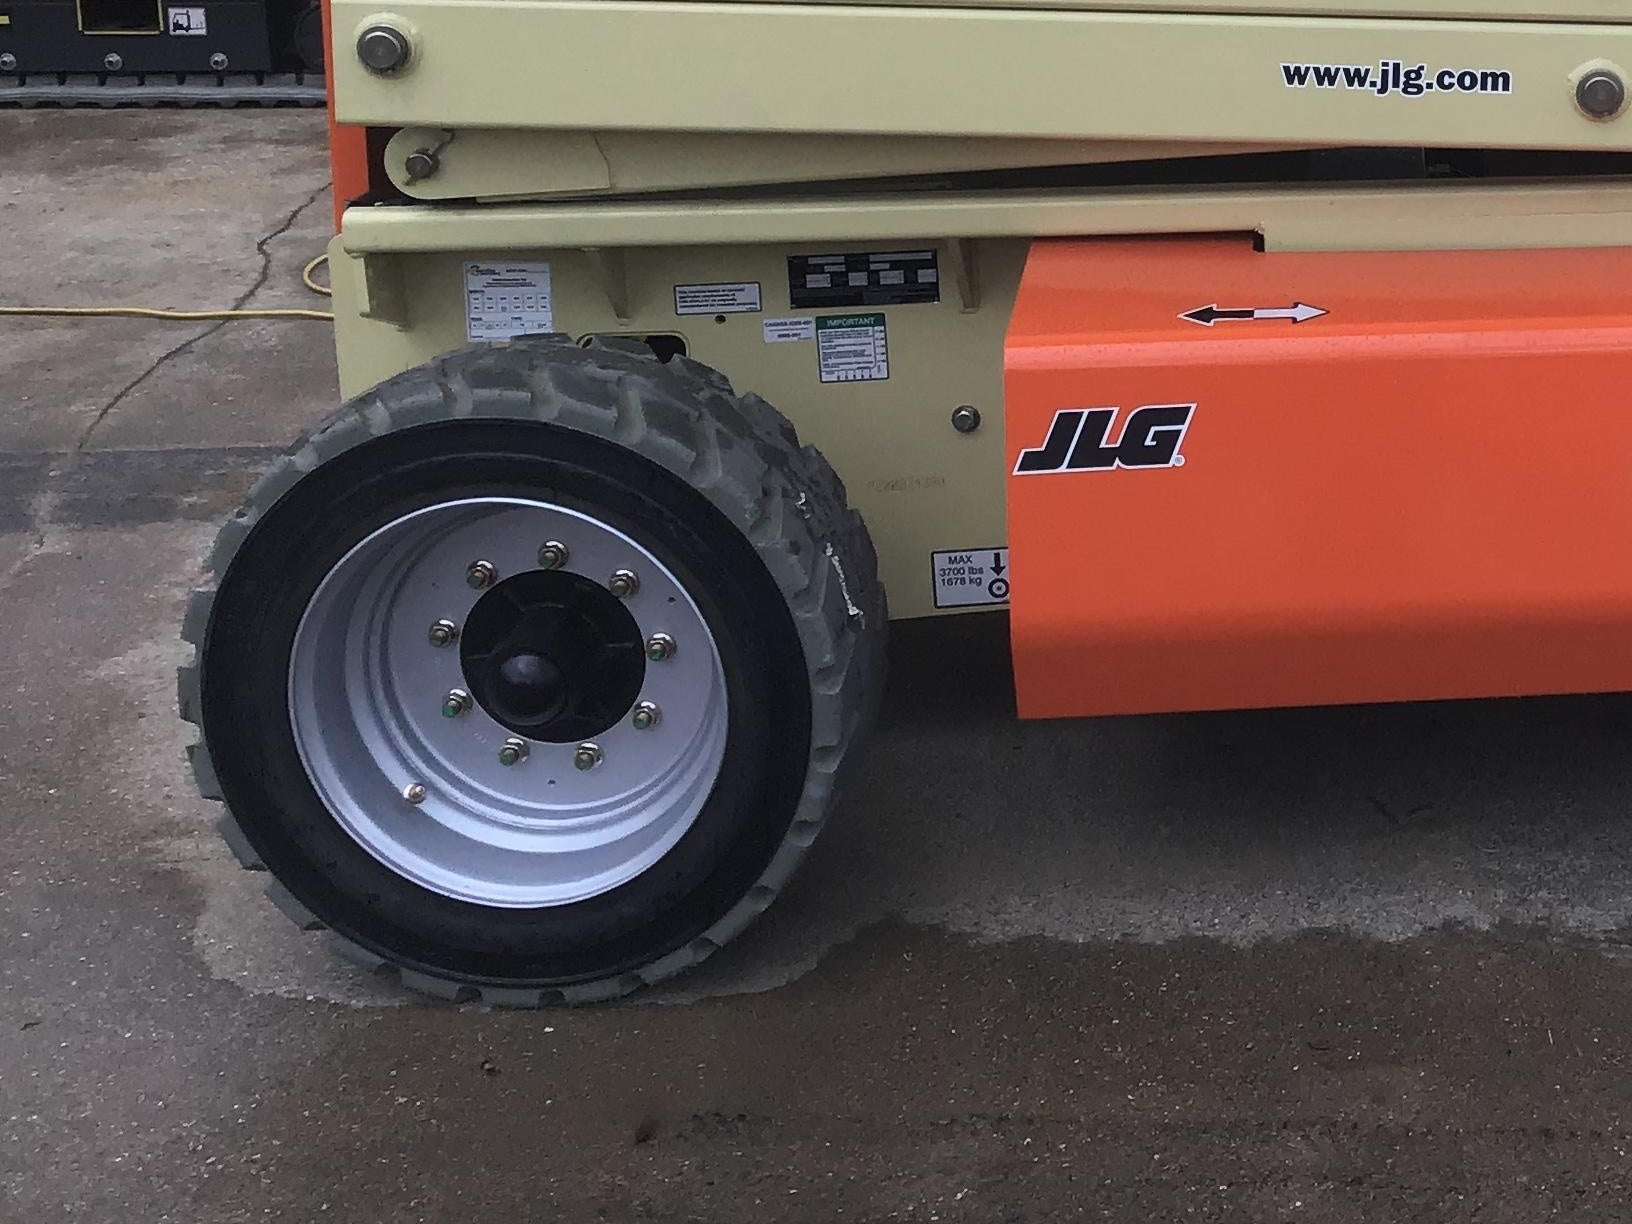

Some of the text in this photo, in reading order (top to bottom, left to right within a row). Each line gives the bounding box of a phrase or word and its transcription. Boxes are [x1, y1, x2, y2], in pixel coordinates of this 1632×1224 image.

[1281, 61, 1511, 96] www.jlg.com
[826, 317, 875, 327] IMPORTANT
[948, 555, 973, 565] MAX
[939, 566, 984, 577] 3700 lbs
[941, 577, 982, 587] 1678 kg
